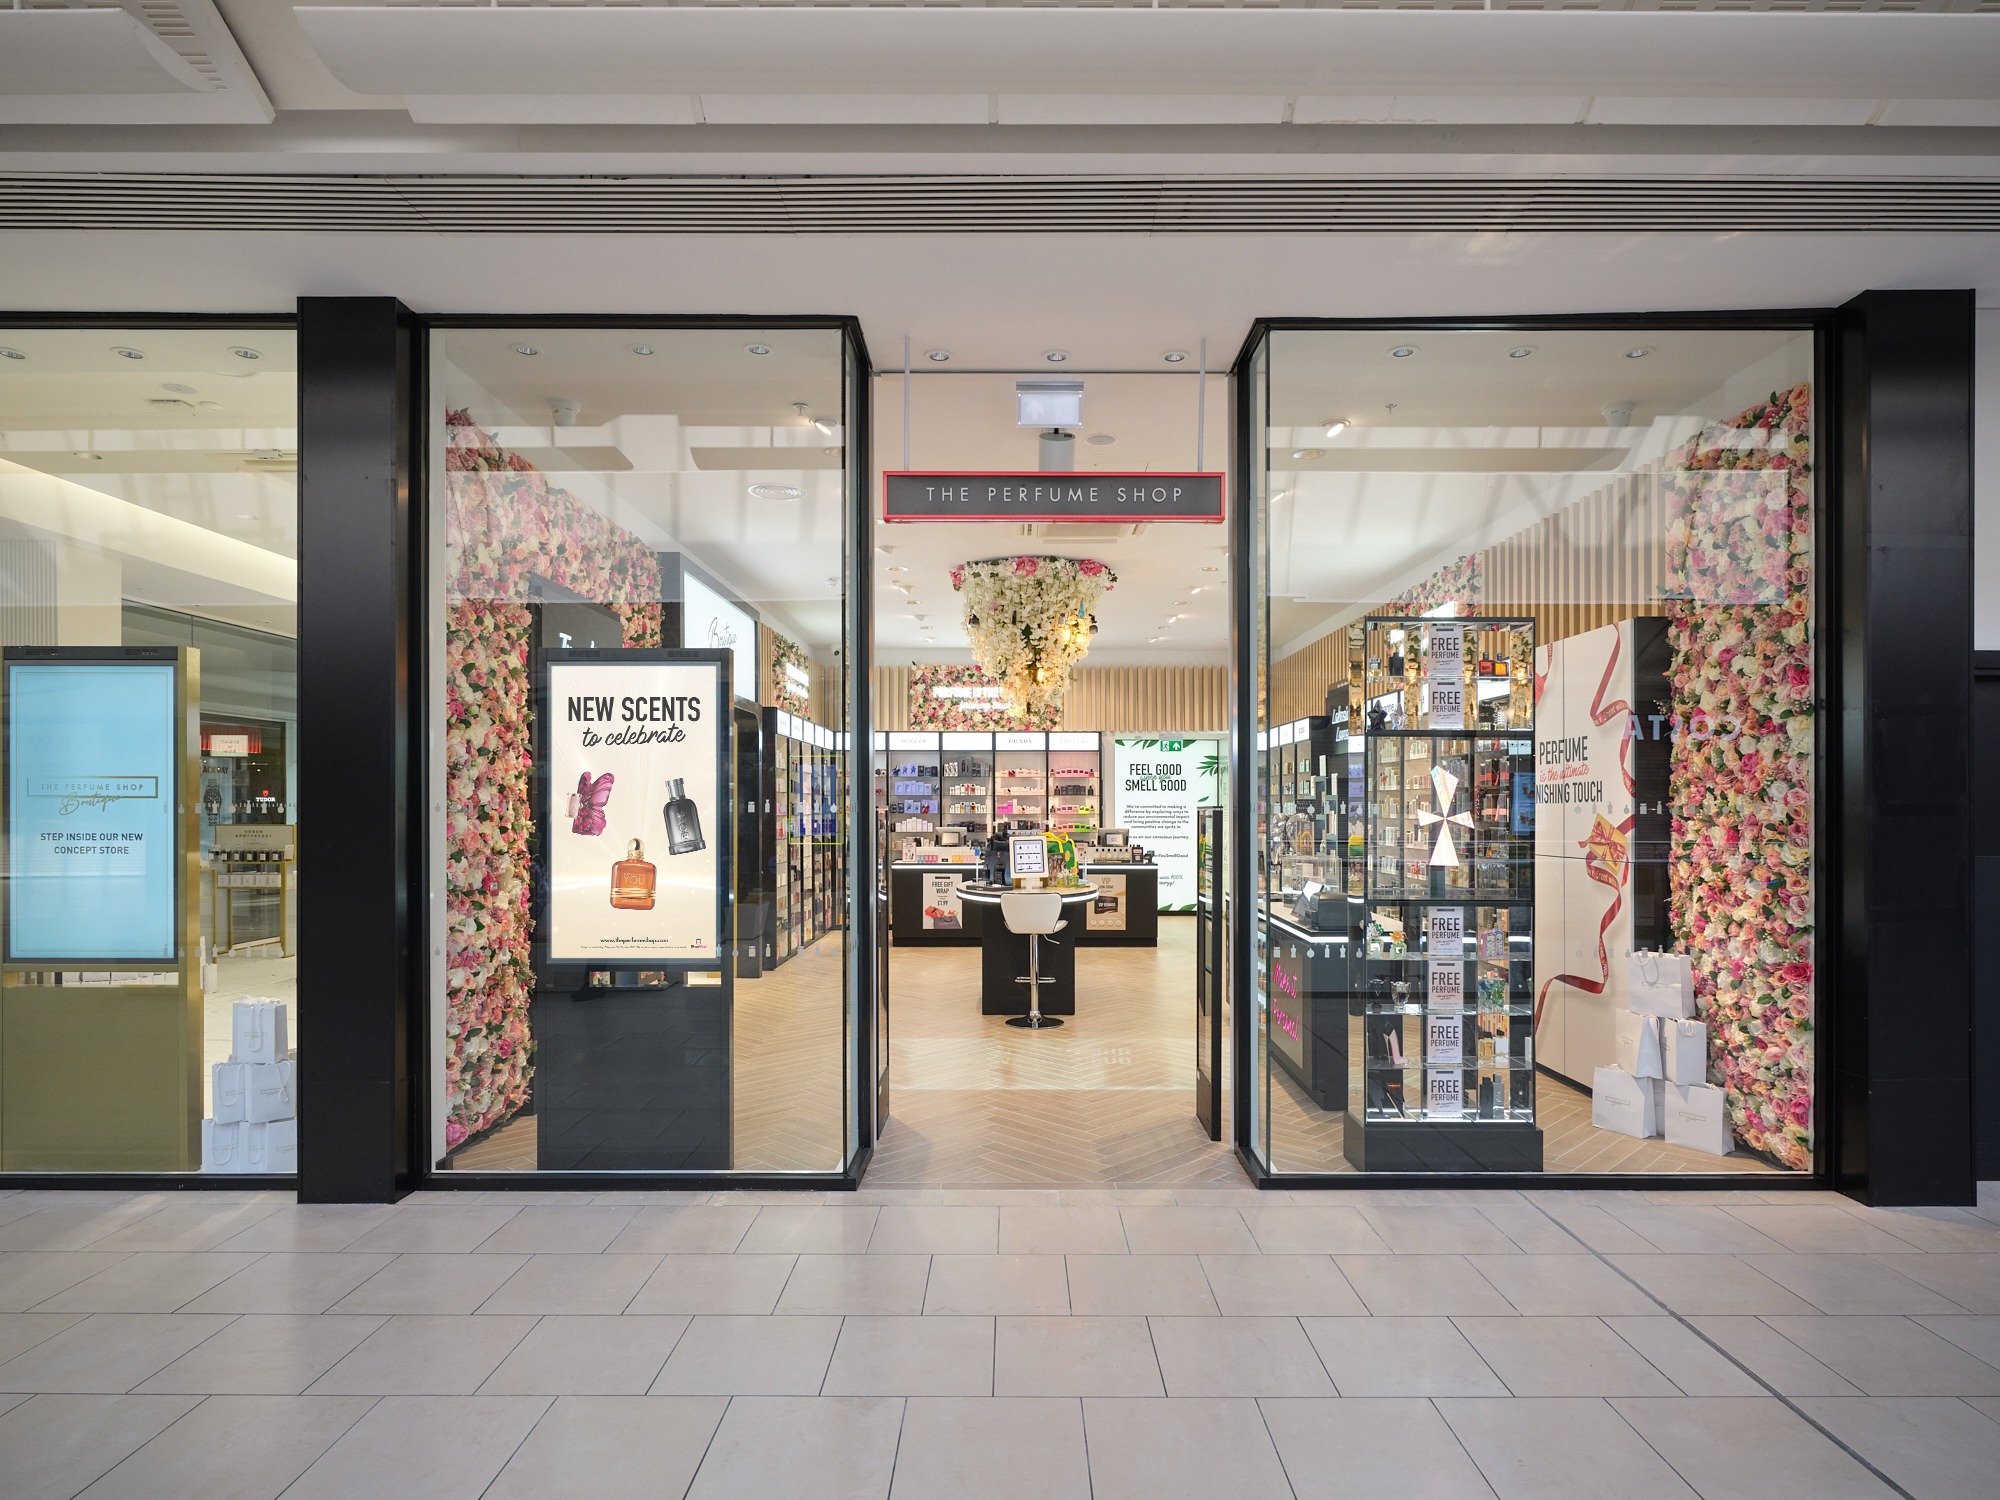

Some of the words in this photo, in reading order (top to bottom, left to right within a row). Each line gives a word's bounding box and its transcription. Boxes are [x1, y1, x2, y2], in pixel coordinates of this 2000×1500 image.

[926, 487, 969, 502] THE
[988, 487, 1099, 502] PERFUME
[1117, 487, 1182, 503] SHOP
[1431, 637, 1460, 651] FREE
[1431, 651, 1460, 659] PERFUME
[1432, 691, 1461, 705] FREE
[568, 696, 615, 721] NEW
[621, 696, 701, 721] SCENTS
[1432, 705, 1461, 713] PERFUME
[582, 727, 603, 747] to
[605, 723, 687, 745] celebrate
[1539, 735, 1588, 766] PERFUME
[1129, 764, 1153, 776] FEEL
[1155, 764, 1182, 776] GOOD
[1540, 769, 1546, 782] is
[1548, 764, 1559, 782] the
[1560, 761, 1590, 780] ultimate
[41, 783, 59, 791] THE
[65, 783, 110, 791] PERFUME
[116, 783, 144, 791] SHOP
[1125, 779, 1158, 792] SMELL
[1160, 779, 1187, 792] GOOD
[1536, 783, 1570, 804] NISHING
[1572, 780, 1603, 803] TOUCH
[59, 792, 122, 815] Boutique
[40, 832, 64, 841] STEP
[66, 832, 97, 841] INSIDE
[99, 832, 119, 841] OUR
[121, 832, 143, 841] NEW
[54, 846, 97, 854] CONCEPT
[99, 846, 130, 854] STORE
[624, 875, 645, 885] YOU
[1431, 917, 1460, 931] FREE
[1431, 931, 1460, 939] PERFUME
[1431, 971, 1461, 986] FREE
[1431, 985, 1461, 994] PERFUME
[1430, 1025, 1460, 1039] FREE
[1430, 1039, 1460, 1047] PERFUME
[1430, 1079, 1460, 1093] FREE
[1430, 1093, 1460, 1101] PERFUME
